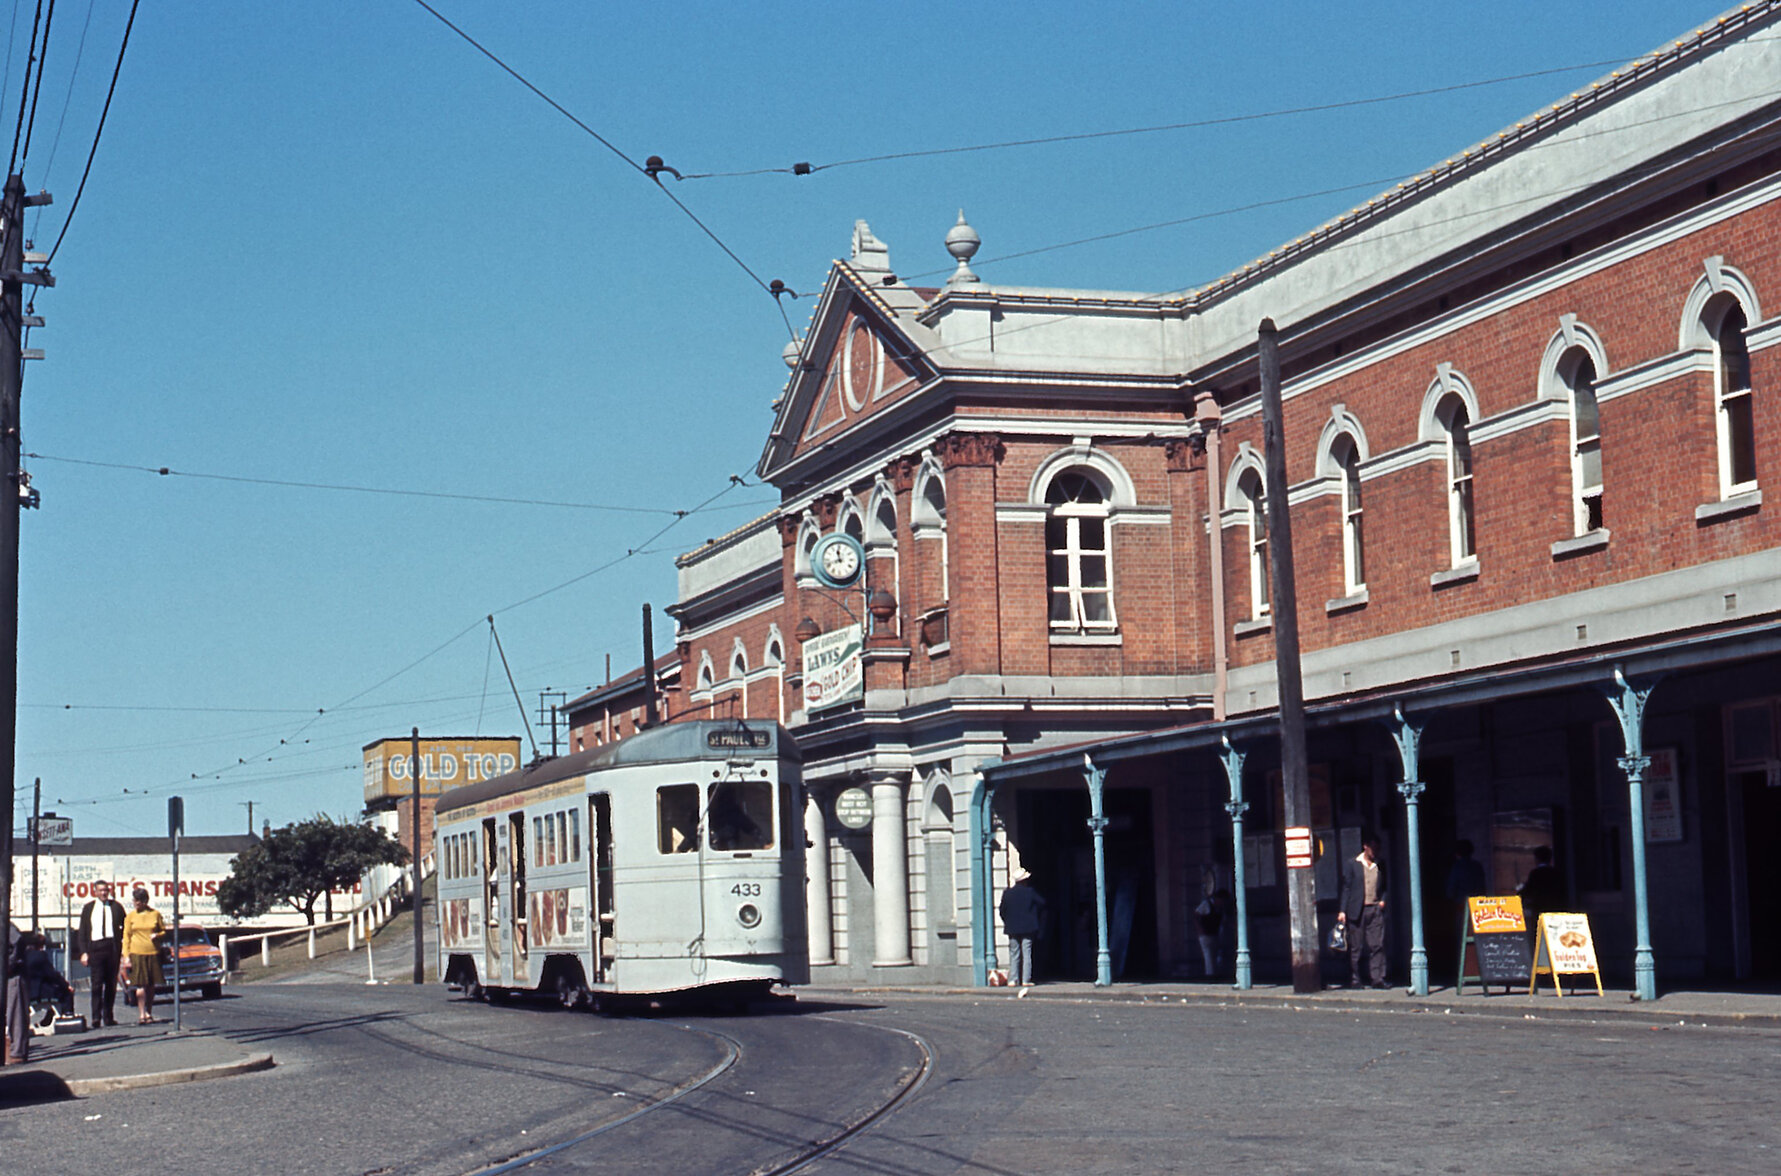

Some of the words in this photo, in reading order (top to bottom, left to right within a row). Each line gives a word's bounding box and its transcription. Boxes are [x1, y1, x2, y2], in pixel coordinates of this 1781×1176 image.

[388, 753, 458, 780] GOLD
[463, 753, 516, 780] TOP
[731, 883, 761, 897] 433
